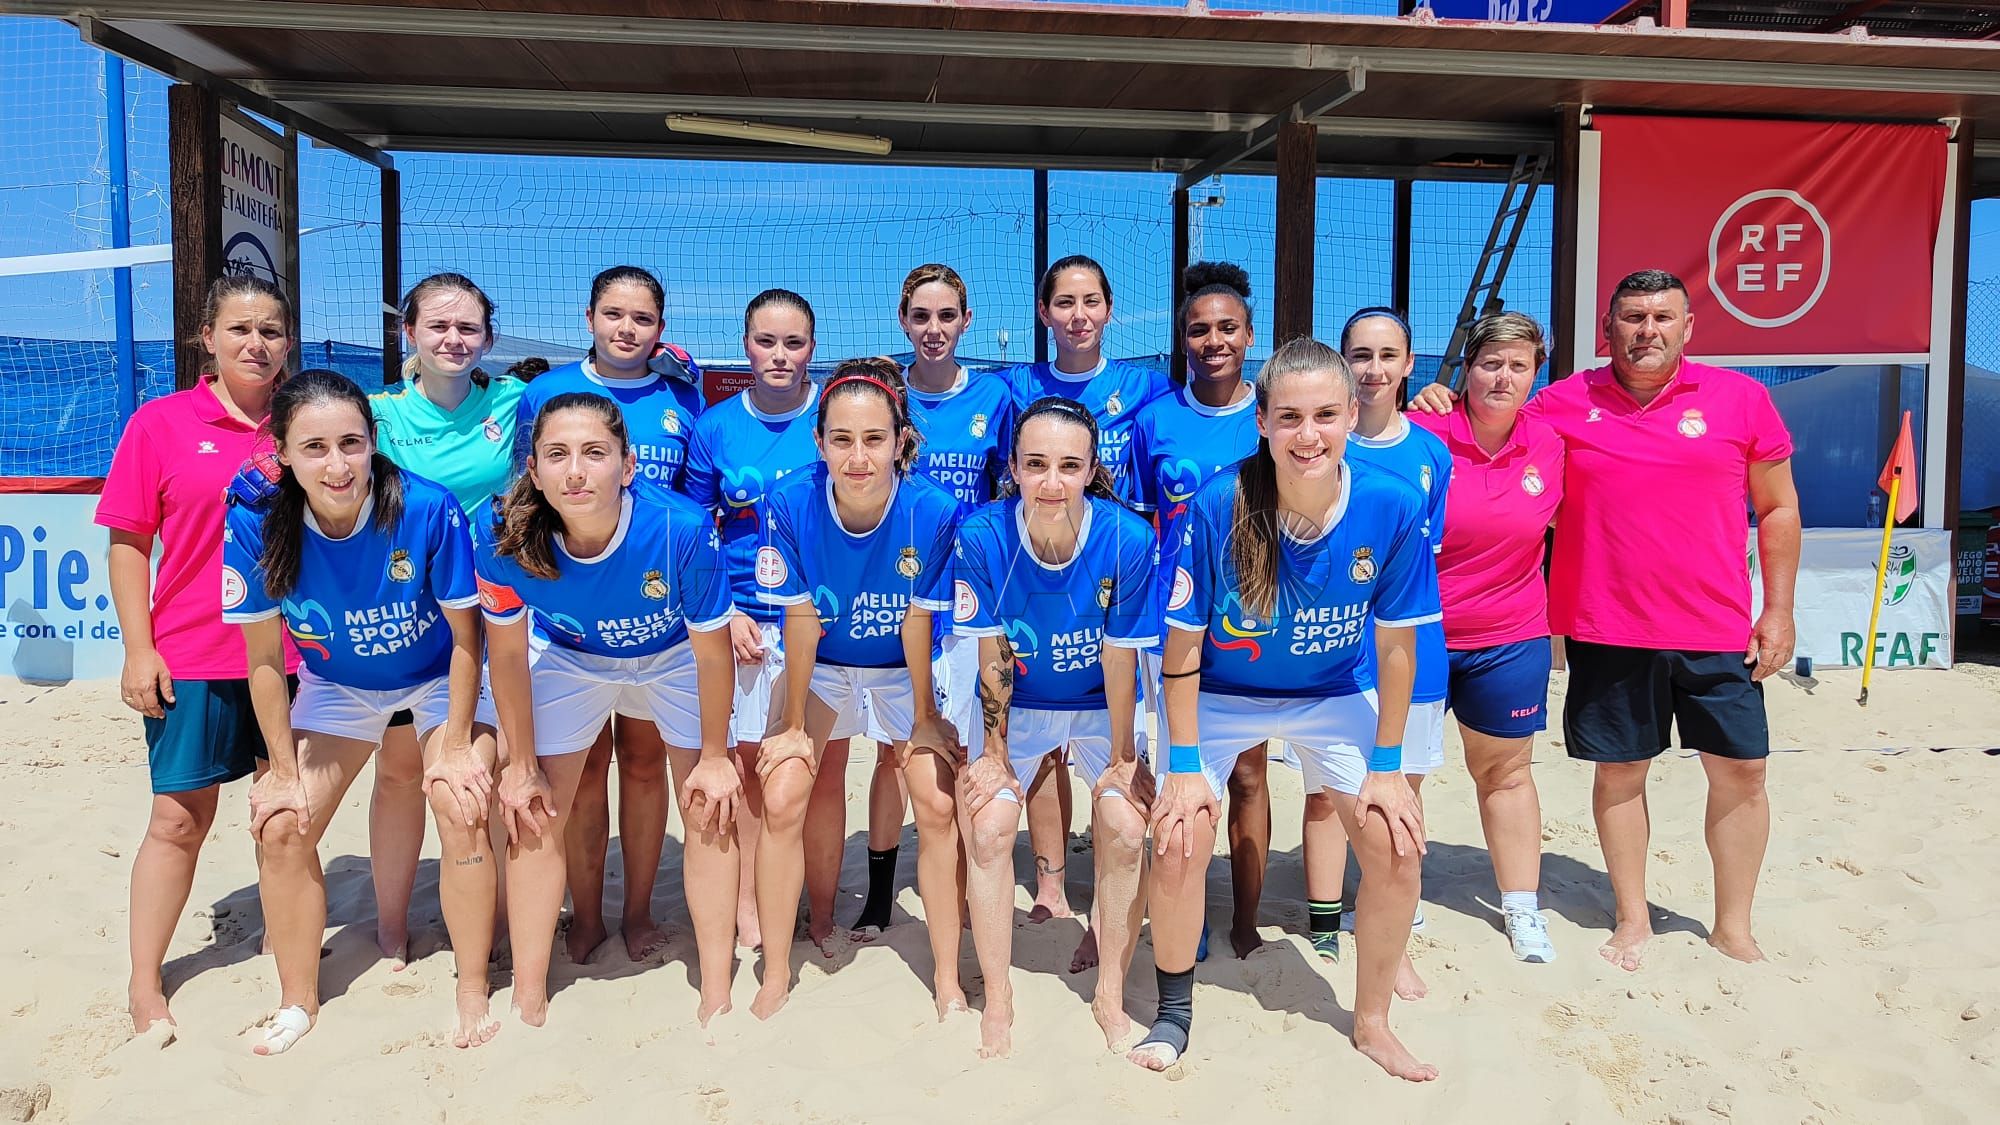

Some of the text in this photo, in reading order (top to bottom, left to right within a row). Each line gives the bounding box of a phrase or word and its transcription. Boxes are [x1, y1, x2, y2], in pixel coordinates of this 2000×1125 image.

[221, 137, 283, 200] ORMONT
[222, 184, 284, 234] ETALISTERÍA
[390, 436, 433, 447] KELME
[635, 463, 677, 481] PORT
[1957, 551, 1983, 560] UEGO
[1958, 559, 1982, 568] MPIO
[1956, 567, 1982, 576] UELO
[1957, 575, 1982, 584] MPIO
[851, 591, 911, 611] MELIL
[851, 609, 906, 625] SPOR
[1293, 600, 1369, 624] MELILL
[14, 624, 57, 639] con
[63, 619, 84, 640] el
[90, 620, 121, 640] de
[850, 624, 902, 640] CAPI
[1051, 624, 1104, 647] MELI
[1052, 641, 1101, 661] SPO
